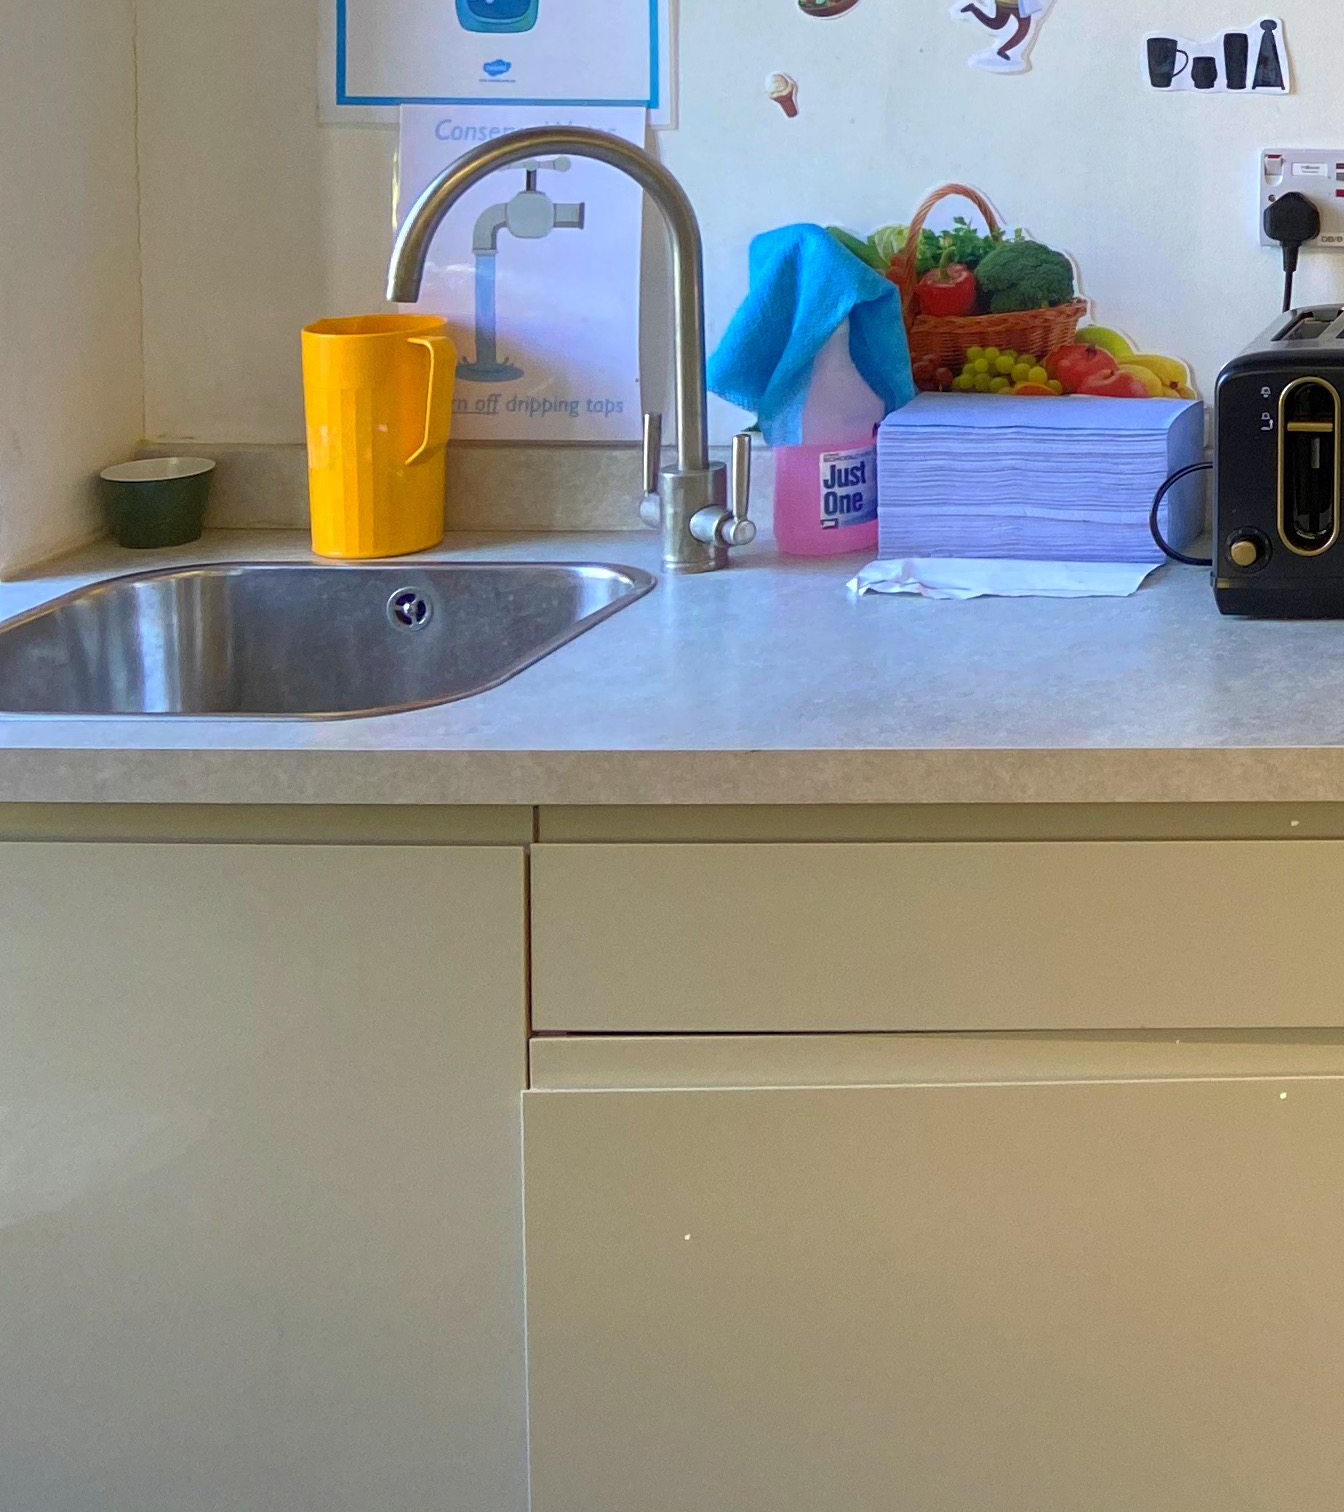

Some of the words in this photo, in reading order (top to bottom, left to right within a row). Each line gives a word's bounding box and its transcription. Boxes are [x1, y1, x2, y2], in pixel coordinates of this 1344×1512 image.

[475, 395, 502, 412] off
[507, 395, 578, 418] dripping
[587, 397, 624, 416] taps
[823, 461, 866, 489] Just
[824, 491, 863, 516] One
